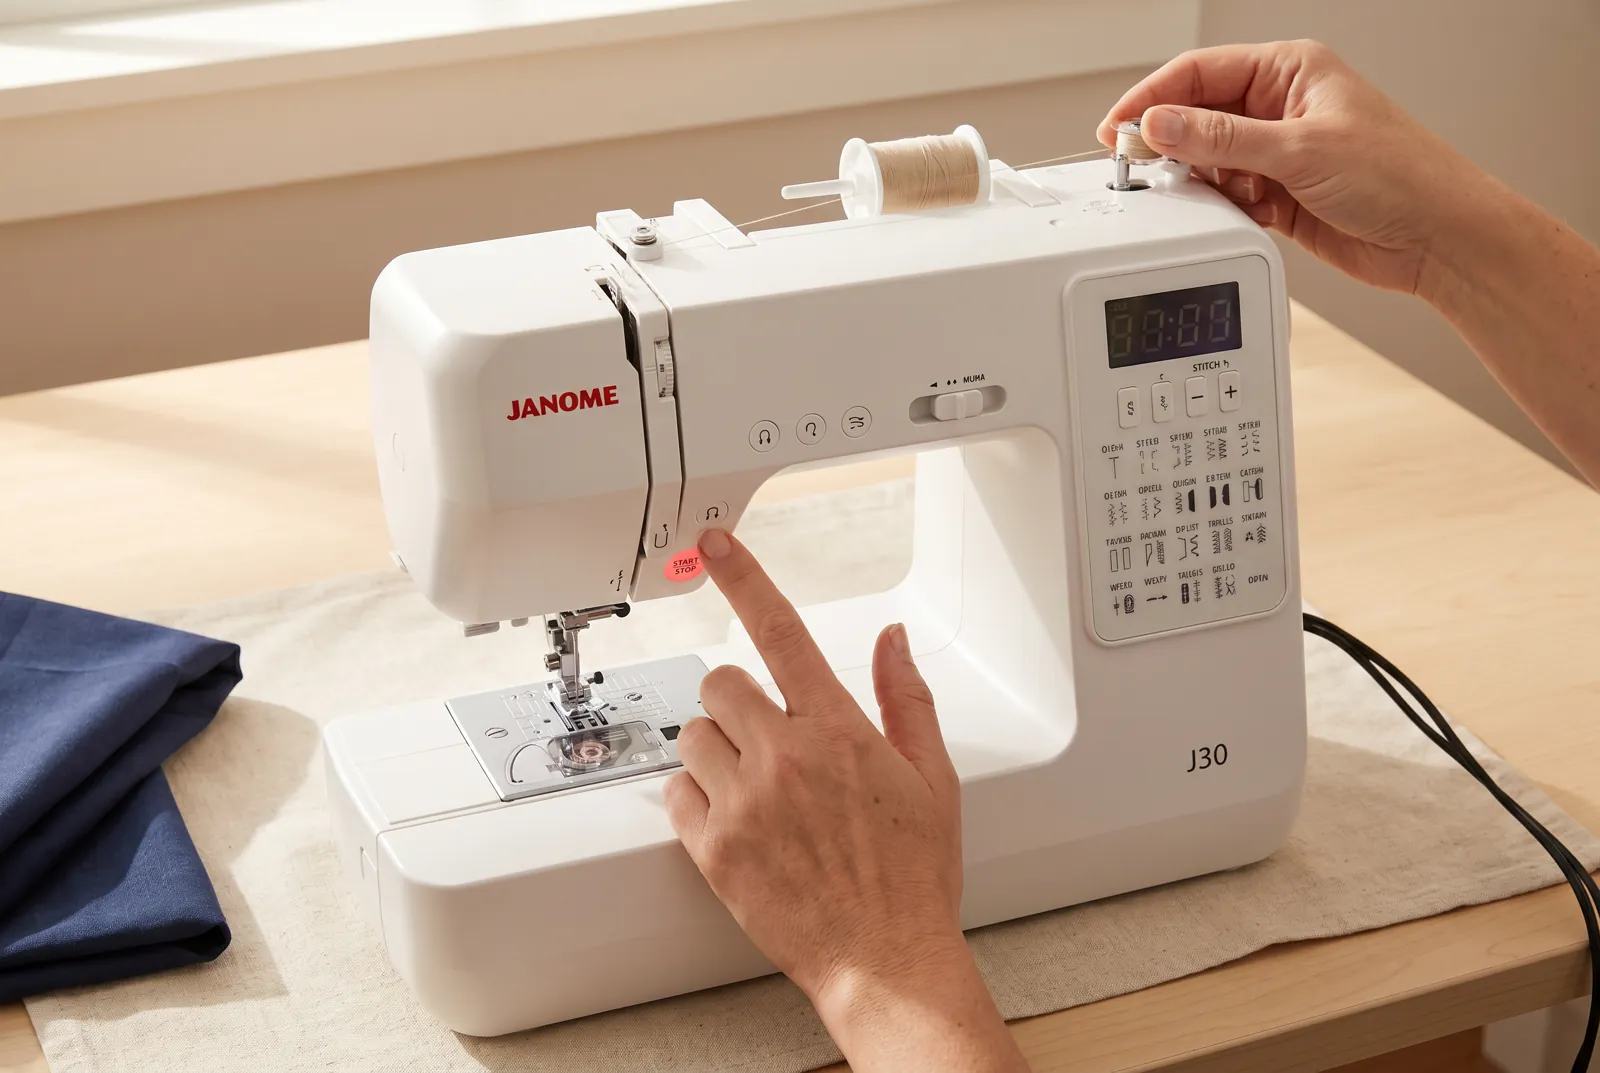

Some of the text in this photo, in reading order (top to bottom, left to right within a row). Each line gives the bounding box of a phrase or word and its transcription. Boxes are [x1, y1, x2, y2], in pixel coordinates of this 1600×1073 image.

[1193, 360, 1220, 372] STITCH
[507, 385, 619, 421] JANOME
[673, 557, 699, 567] START
[675, 565, 697, 575] STOP
[1187, 743, 1228, 773] J30
